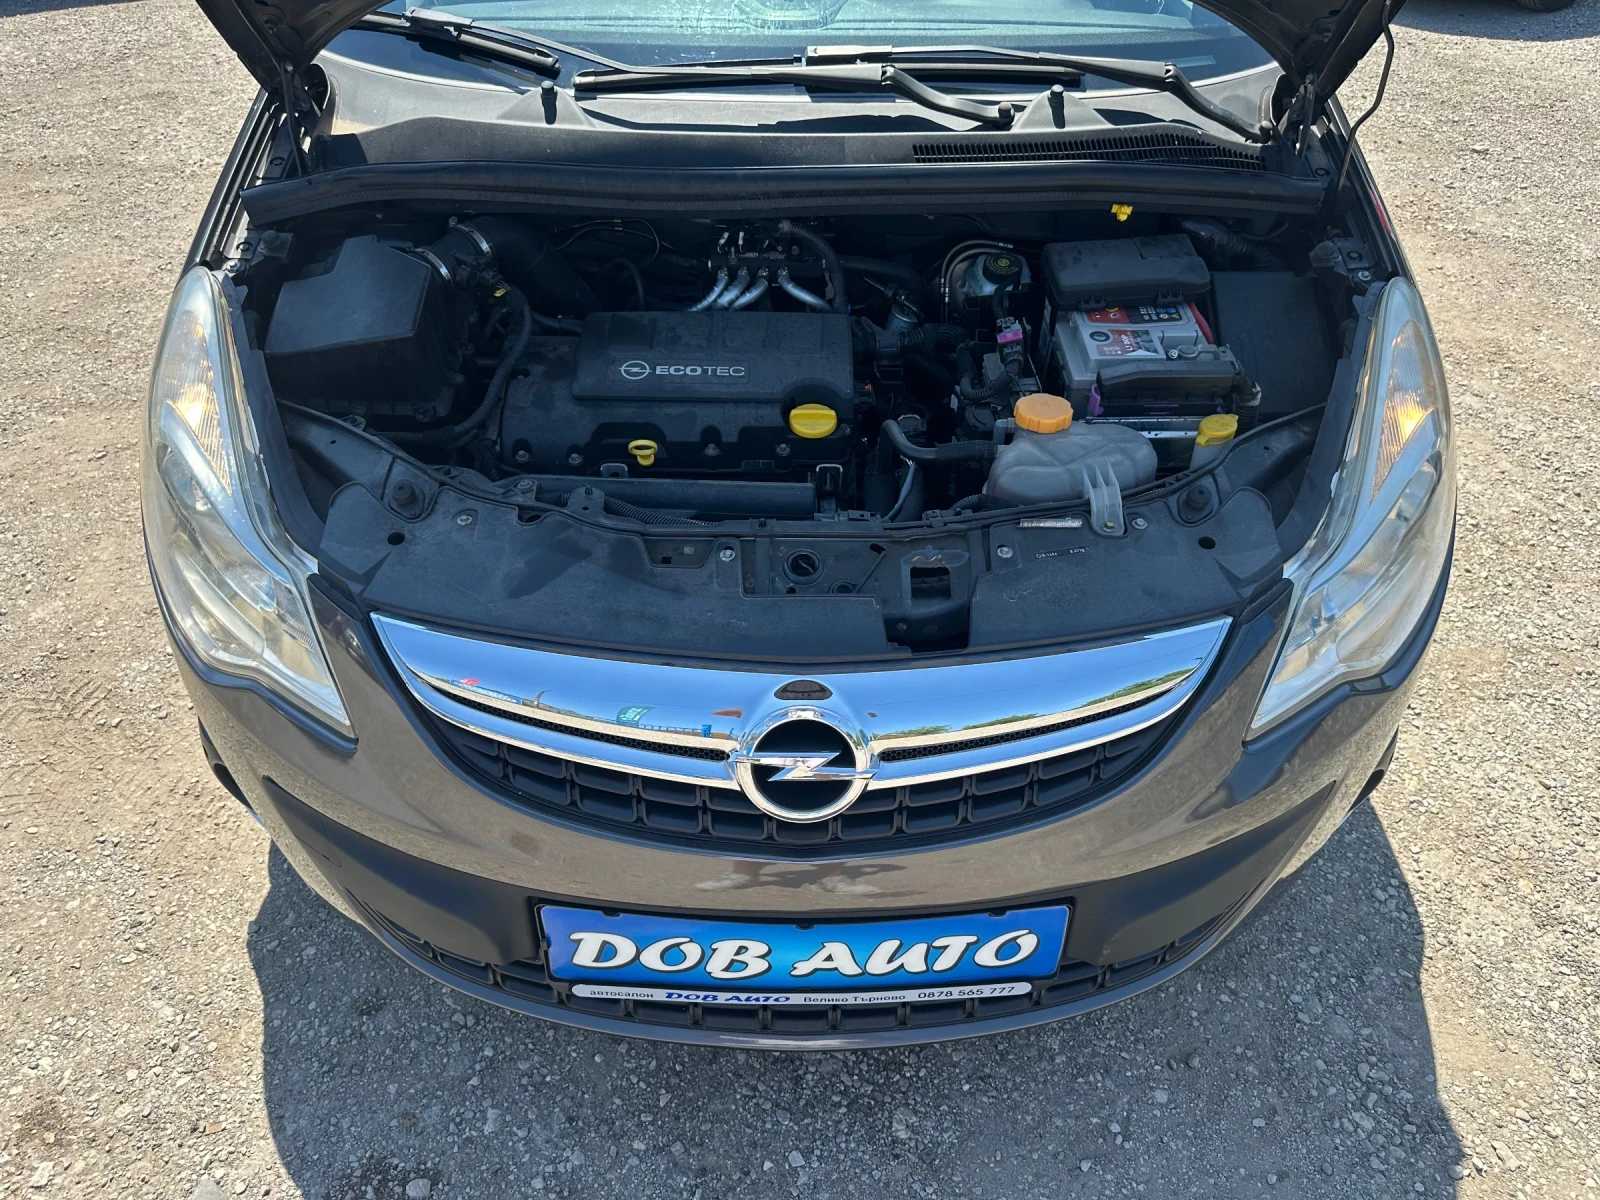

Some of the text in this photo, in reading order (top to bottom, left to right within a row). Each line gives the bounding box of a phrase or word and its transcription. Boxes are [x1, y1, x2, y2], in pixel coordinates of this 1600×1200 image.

[656, 364, 746, 377] ECOTEC
[568, 930, 1039, 980] DOB AUTO
[590, 990, 654, 999] автосалон
[803, 996, 849, 1004] Велико
[853, 995, 907, 1003] Търново
[917, 990, 953, 998] 0878
[957, 988, 985, 996] 565
[989, 986, 1015, 994] 777
